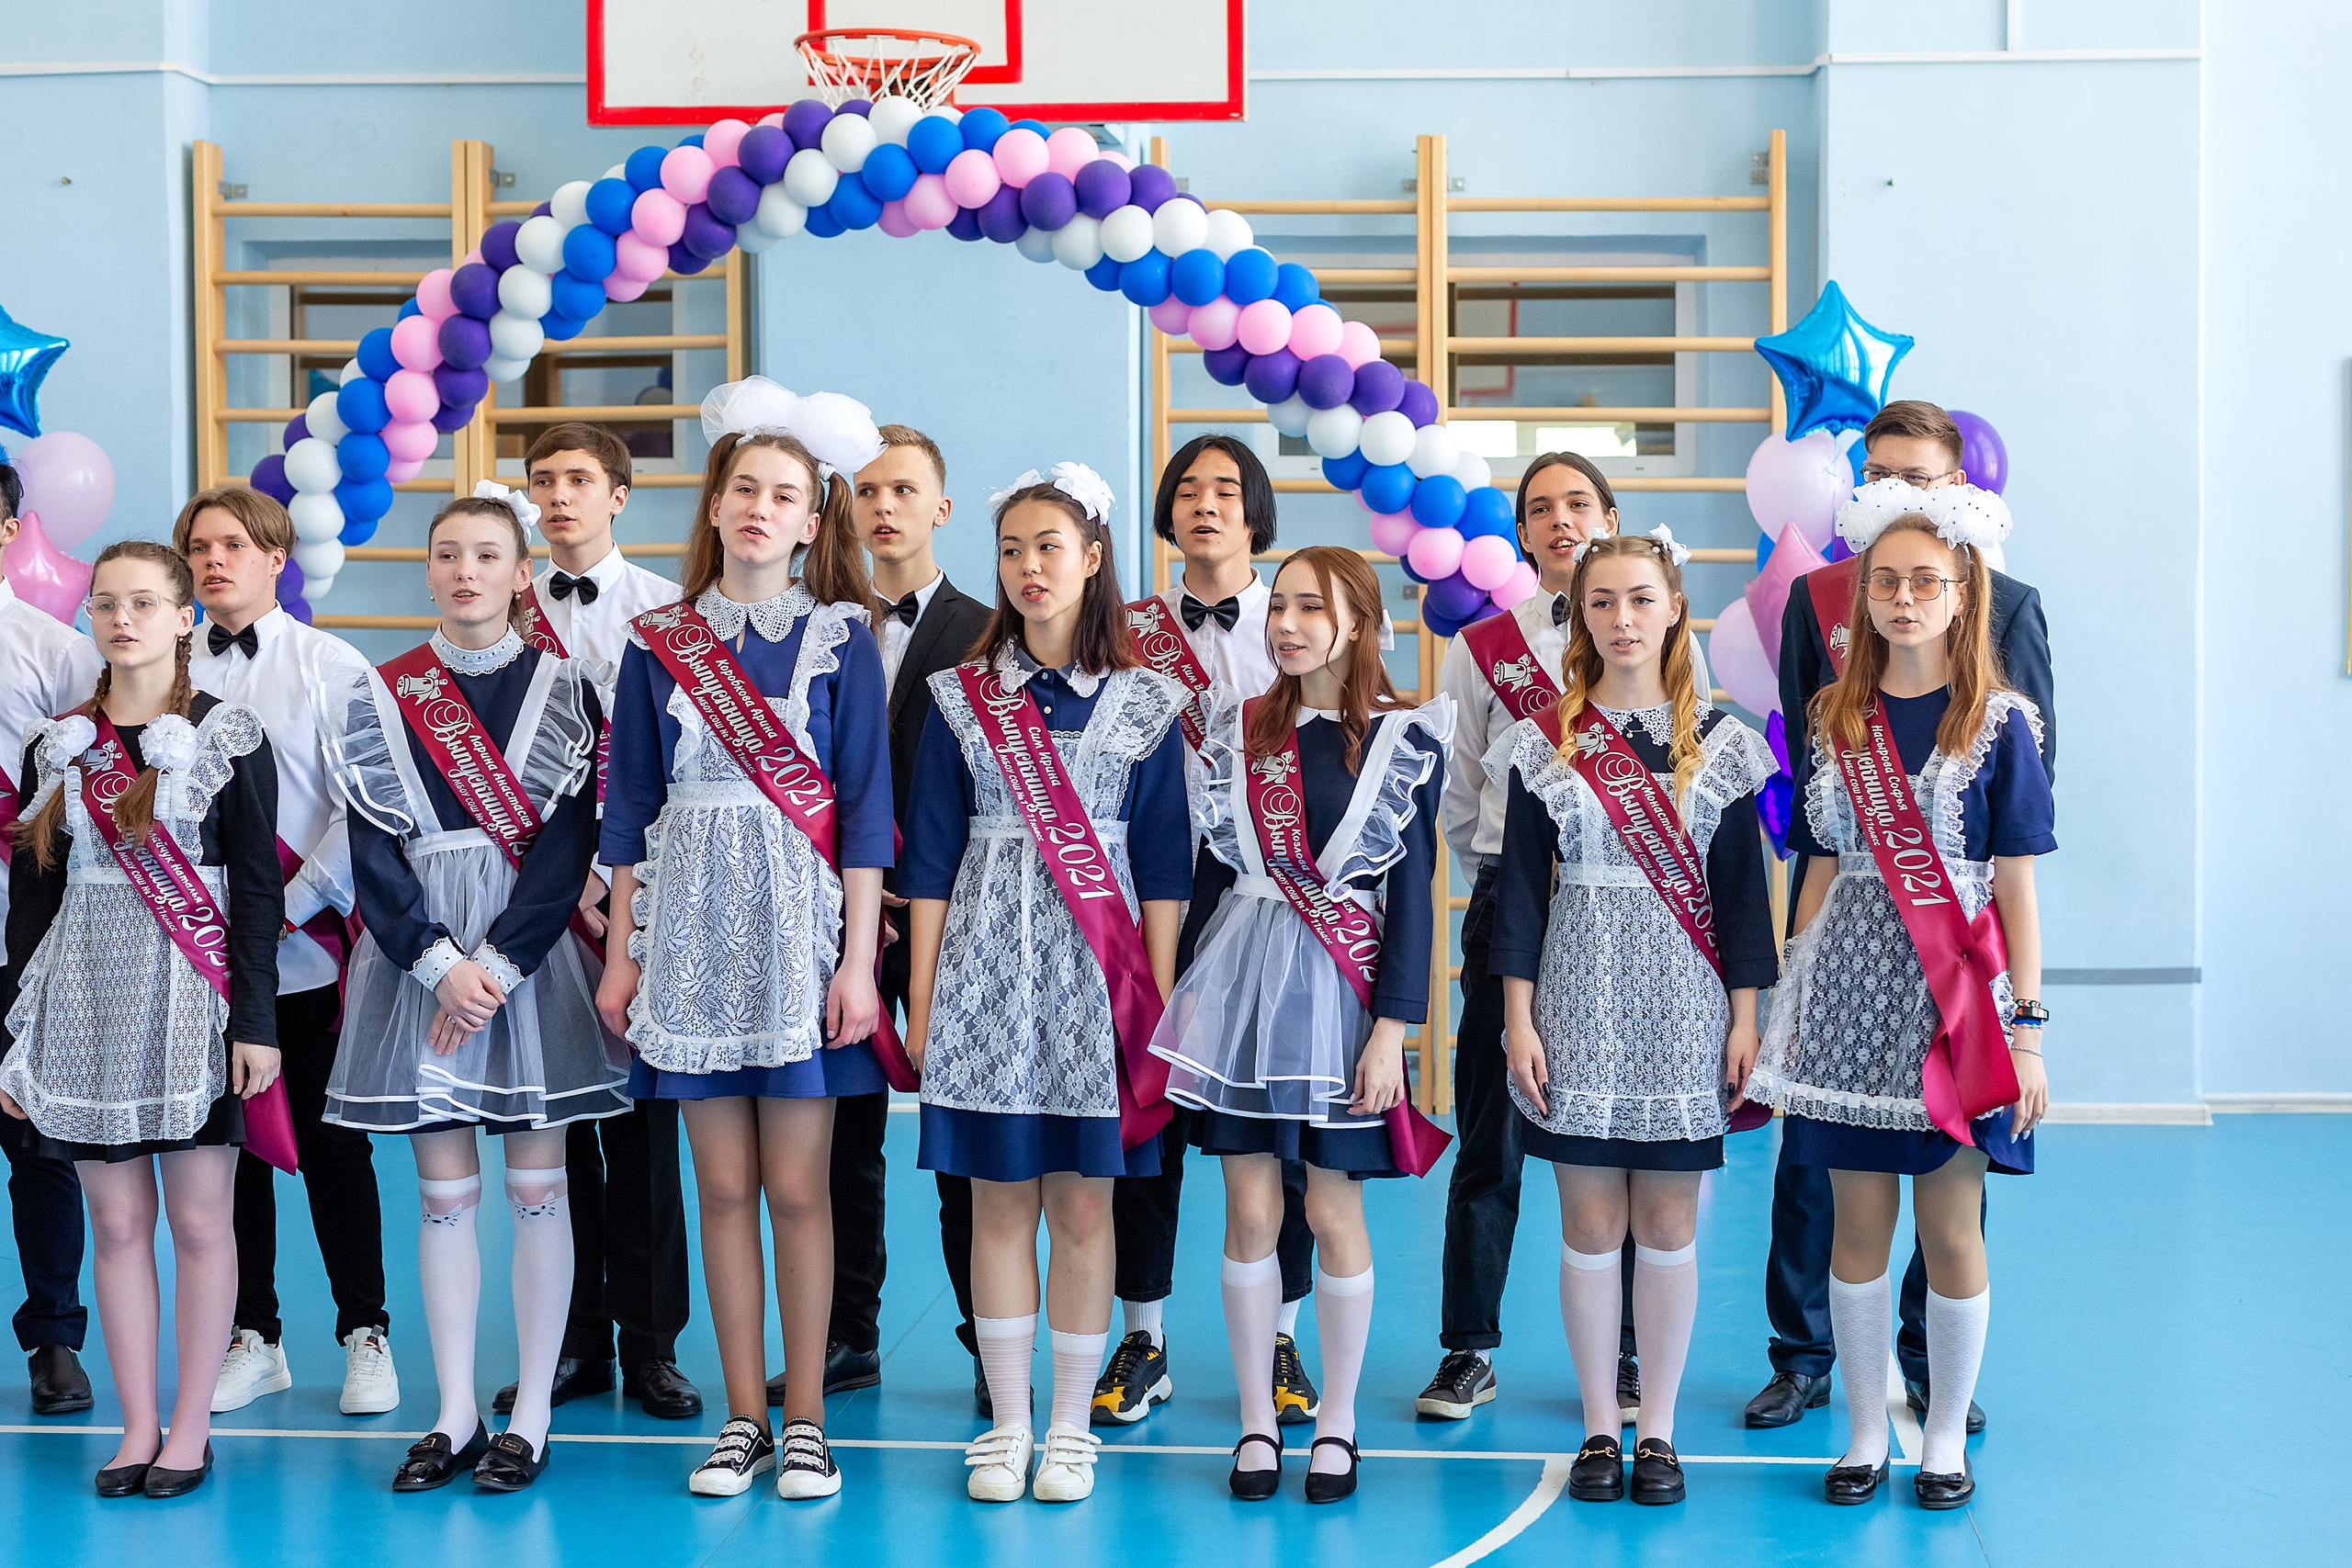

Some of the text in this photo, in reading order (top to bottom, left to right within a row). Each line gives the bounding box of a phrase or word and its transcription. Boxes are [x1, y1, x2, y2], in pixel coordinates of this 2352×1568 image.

[715, 659, 778, 739] Коробкова Арина
[1181, 663, 1198, 684] Ким
[666, 624, 834, 818] Выпускница 2021
[695, 696, 714, 715] МБОУ
[709, 713, 724, 730] СОШ
[424, 698, 519, 840] Выпускница
[469, 734, 499, 771] Ларина
[492, 772, 533, 828] Анастасия
[979, 672, 1115, 900] Выпускница 2021
[999, 754, 1015, 775] МБОУ
[1008, 774, 1022, 791] СОШ
[1028, 727, 1062, 787] Сим Ирина
[1843, 758, 1859, 777] МБОУ
[1849, 777, 1863, 795] СОШ
[1871, 724, 1908, 811] Насырова Софья
[452, 778, 470, 798] МБОУ
[465, 797, 480, 813] СОШ
[1291, 829, 1311, 872] Козлова
[1595, 751, 1720, 959] Выпускница 202
[1625, 834, 1643, 857] МБОУ
[1637, 854, 1652, 870] СОШ
[1641, 785, 1702, 885] Монастырная Дарья
[119, 851, 137, 871] МБОУ
[131, 869, 143, 886] СОШ
[171, 863, 204, 903] Наталья
[1261, 784, 1342, 925] Выпускница
[1332, 919, 1381, 983] 202
[1272, 868, 1287, 886] МБОУ
[1284, 884, 1300, 901] СОШ
[1883, 827, 1951, 907] 2021
[178, 906, 232, 978] 202
